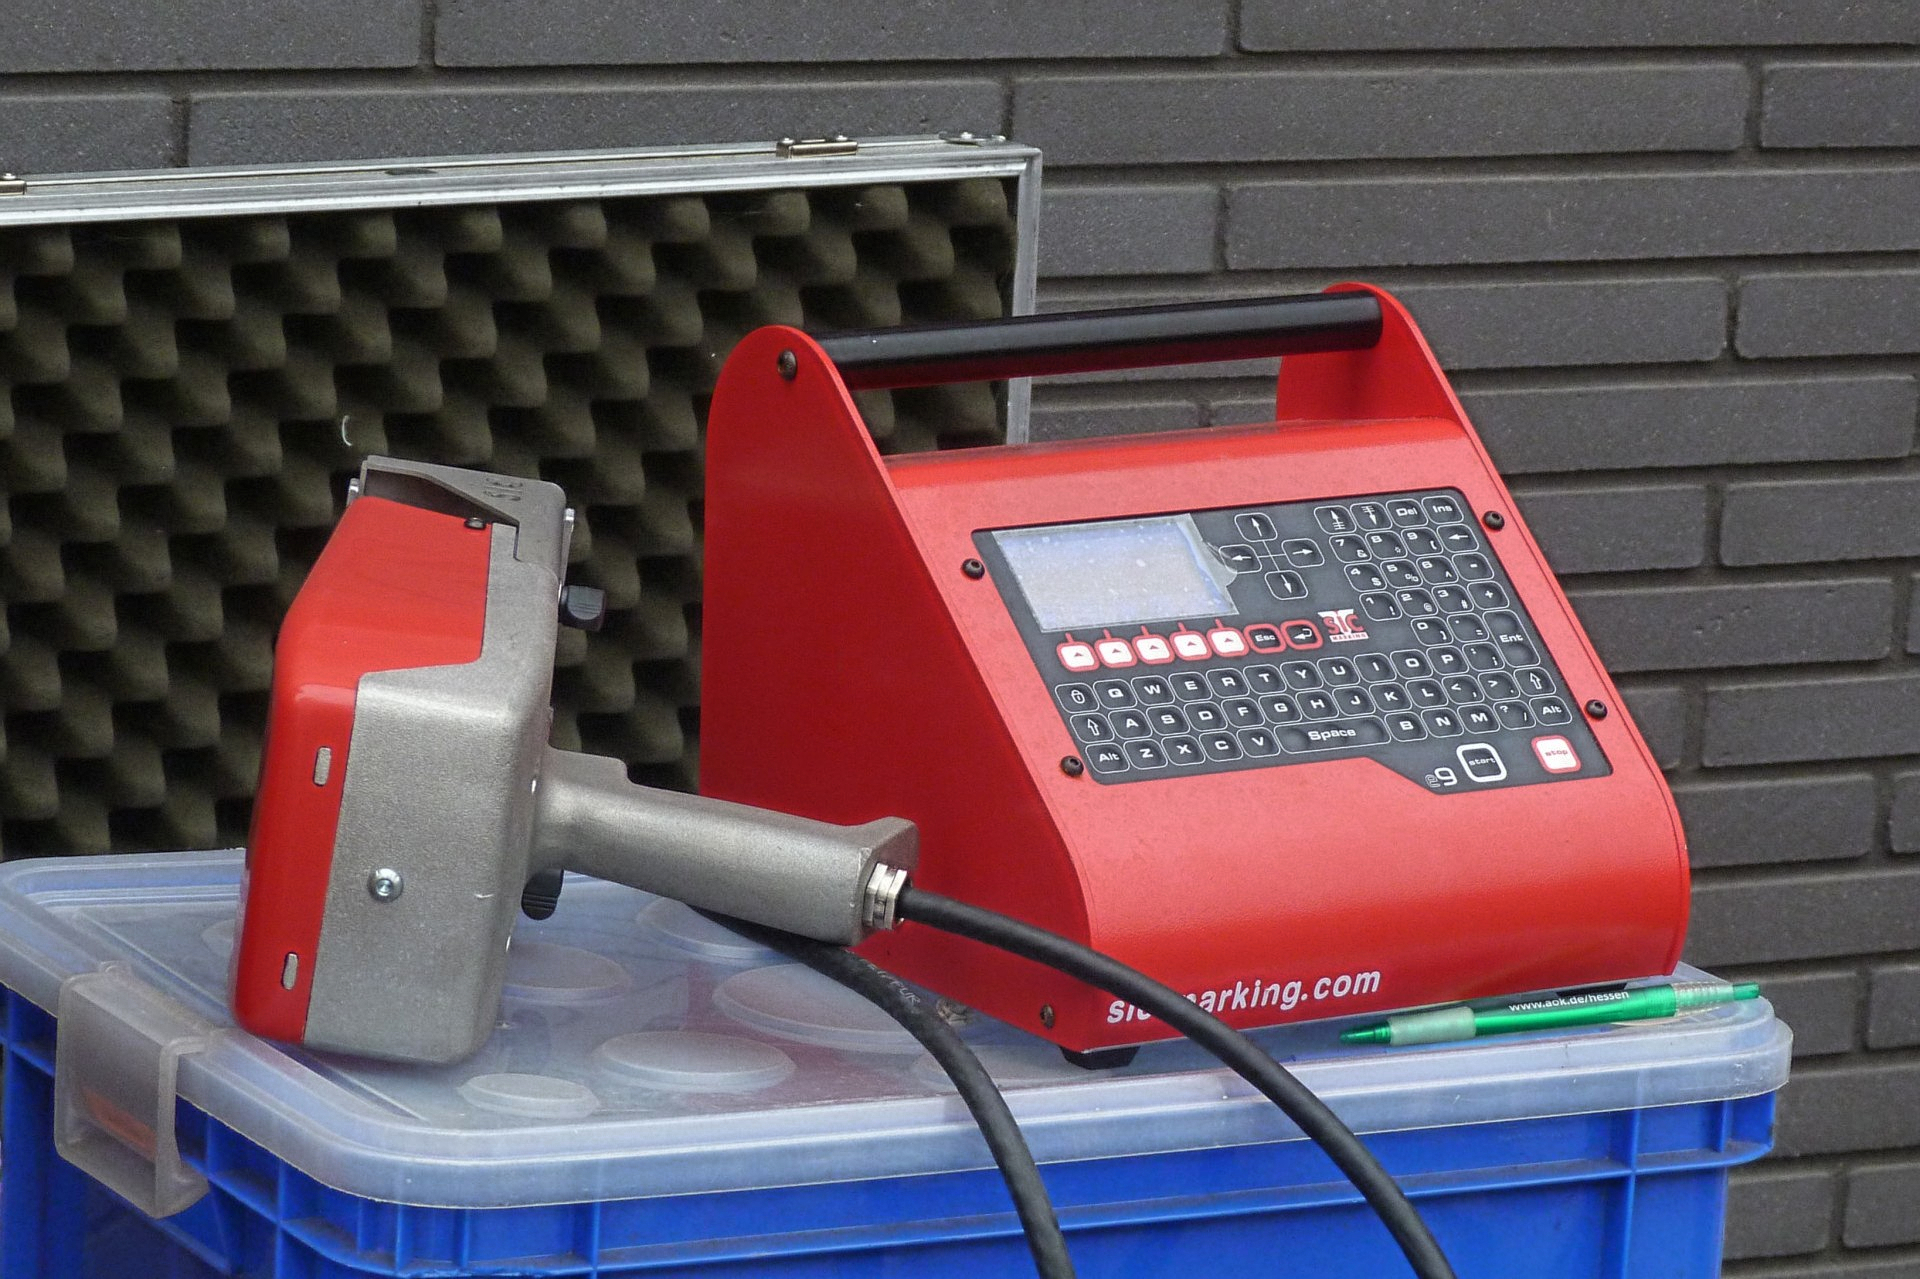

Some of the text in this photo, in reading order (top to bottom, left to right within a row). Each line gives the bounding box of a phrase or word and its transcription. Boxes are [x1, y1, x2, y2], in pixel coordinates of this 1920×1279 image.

[1396, 508, 1417, 516] Del
[1401, 593, 1412, 601] 2
[1323, 610, 1364, 634] SIC
[1406, 658, 1419, 667] O
[1441, 655, 1453, 663] P
[1332, 666, 1345, 675] U
[1373, 663, 1379, 671] I
[1259, 674, 1269, 682] T
[1295, 670, 1306, 678] Y
[1185, 681, 1197, 690] E
[1222, 677, 1235, 686] R
[1144, 685, 1160, 694] W
[1422, 689, 1433, 697] L
[1351, 696, 1360, 704] J
[1384, 692, 1398, 701] K
[1274, 703, 1288, 712] G
[1311, 699, 1324, 708] H
[1238, 707, 1248, 716] F
[1543, 706, 1561, 714] Alt
[1161, 715, 1175, 724] S
[1198, 711, 1212, 720] D
[1471, 713, 1488, 722] M
[1127, 719, 1138, 728] A
[1400, 721, 1413, 730] B
[1436, 717, 1450, 726] N
[1308, 730, 1356, 740] Space
[1215, 741, 1228, 750] C
[1252, 737, 1263, 745] V
[1140, 749, 1153, 758] Z
[1177, 745, 1191, 754] X
[1545, 749, 1568, 757] stop
[1100, 753, 1119, 762] Alt
[1468, 757, 1496, 766] start
[1107, 970, 1381, 1024] sicarking.com
[1508, 991, 1630, 1012] www.aok.de/hessen
